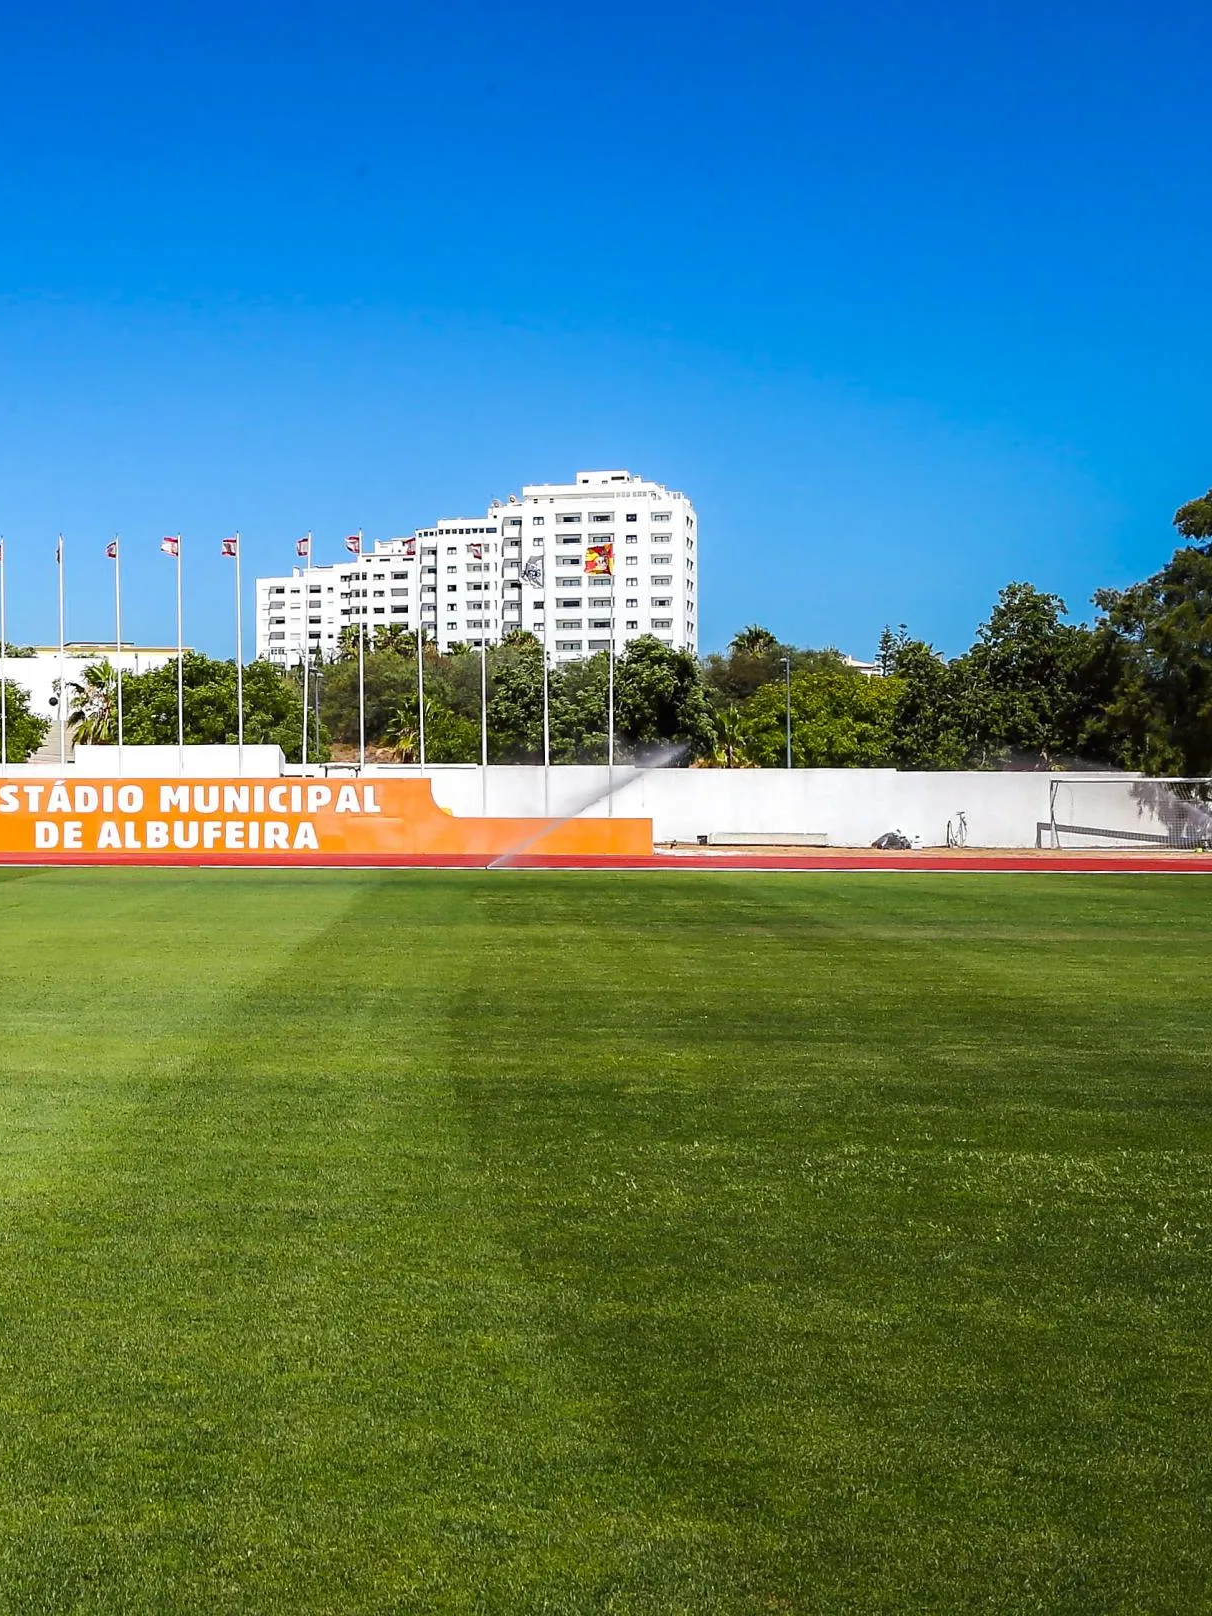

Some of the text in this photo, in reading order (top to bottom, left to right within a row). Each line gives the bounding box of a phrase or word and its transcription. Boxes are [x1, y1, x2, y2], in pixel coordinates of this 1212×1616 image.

[160, 785, 381, 813] MUNICIPAL
[35, 821, 319, 849] DE ALBUFEIRA
